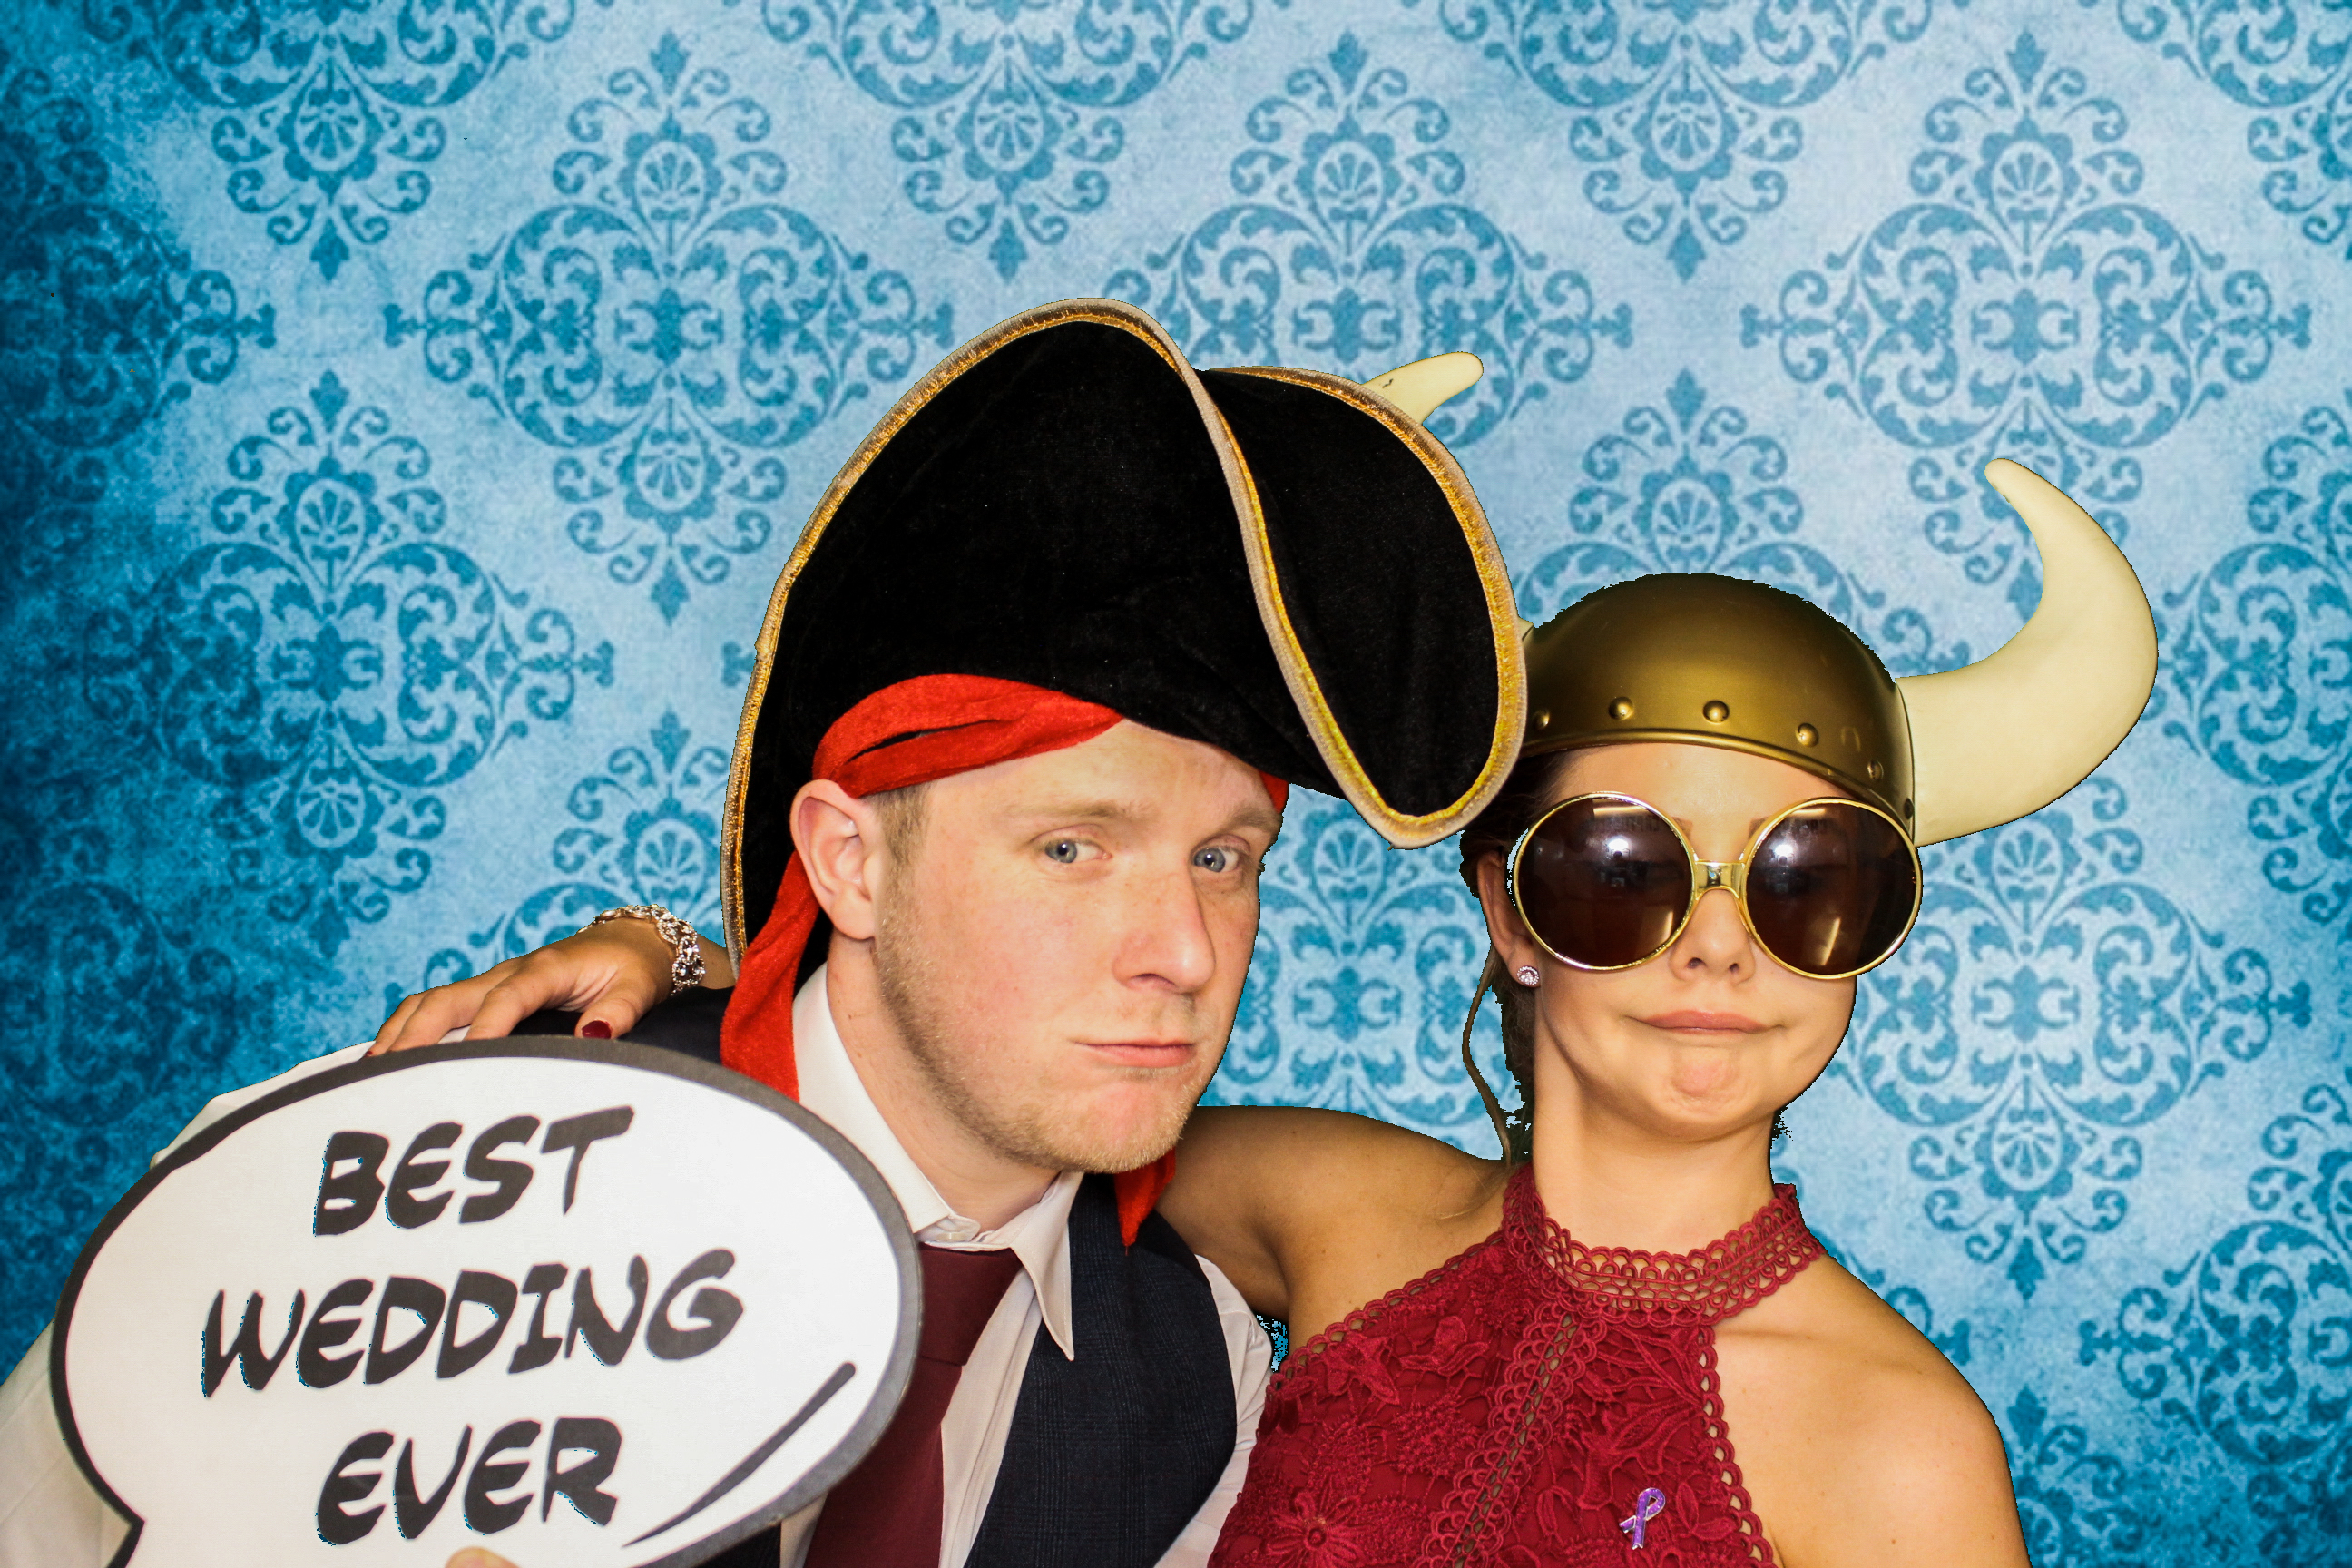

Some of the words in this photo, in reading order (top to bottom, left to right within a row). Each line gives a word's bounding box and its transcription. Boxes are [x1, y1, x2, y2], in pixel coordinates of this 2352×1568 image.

[312, 1105, 635, 1237] BEST
[201, 1249, 744, 1399] WEDDING
[314, 1416, 623, 1547] EVER
